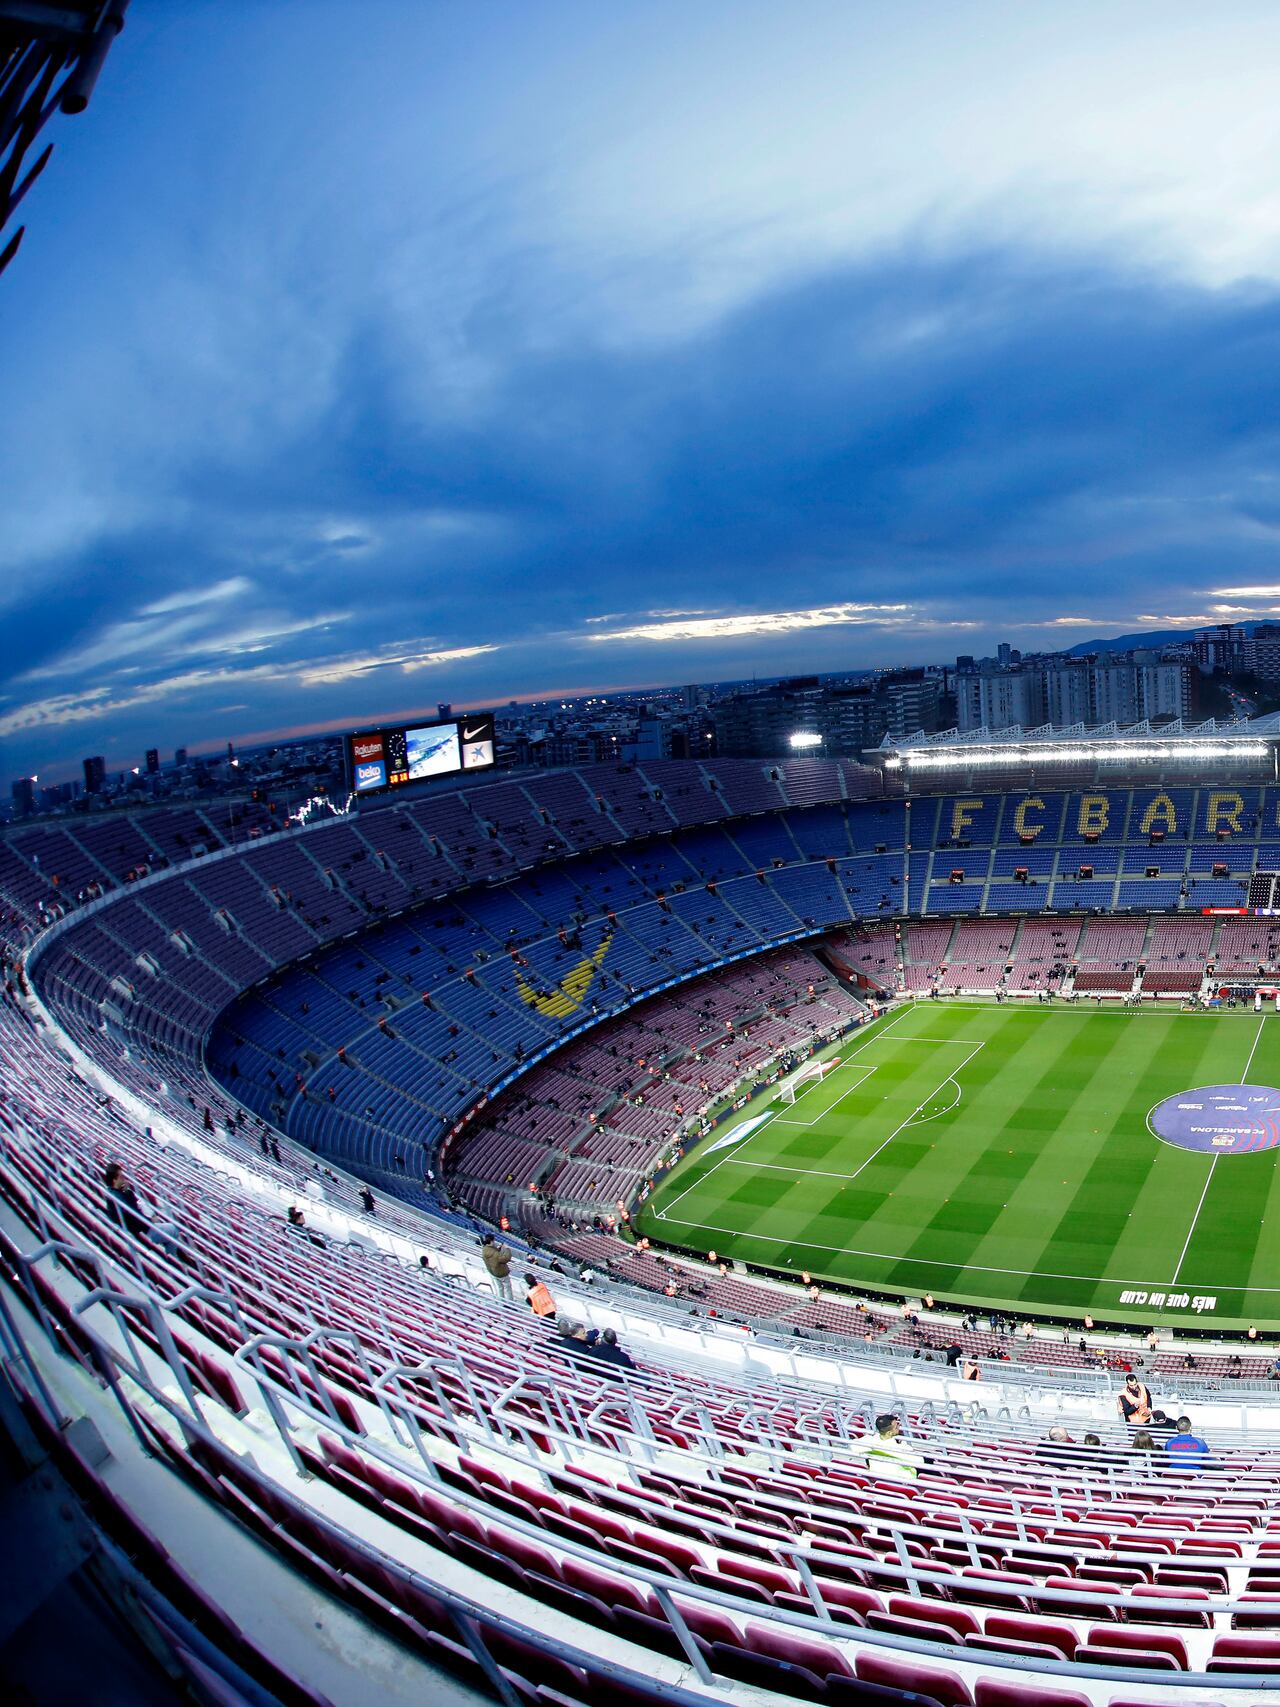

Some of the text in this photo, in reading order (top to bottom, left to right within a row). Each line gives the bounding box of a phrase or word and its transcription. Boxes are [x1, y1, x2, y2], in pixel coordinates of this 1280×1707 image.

[354, 743, 382, 756] Rakuten
[358, 765, 381, 779] beko
[1190, 1126, 1251, 1134] BARCELONA
[1119, 1290, 1217, 1313] MÉS QUE UN CLUB
